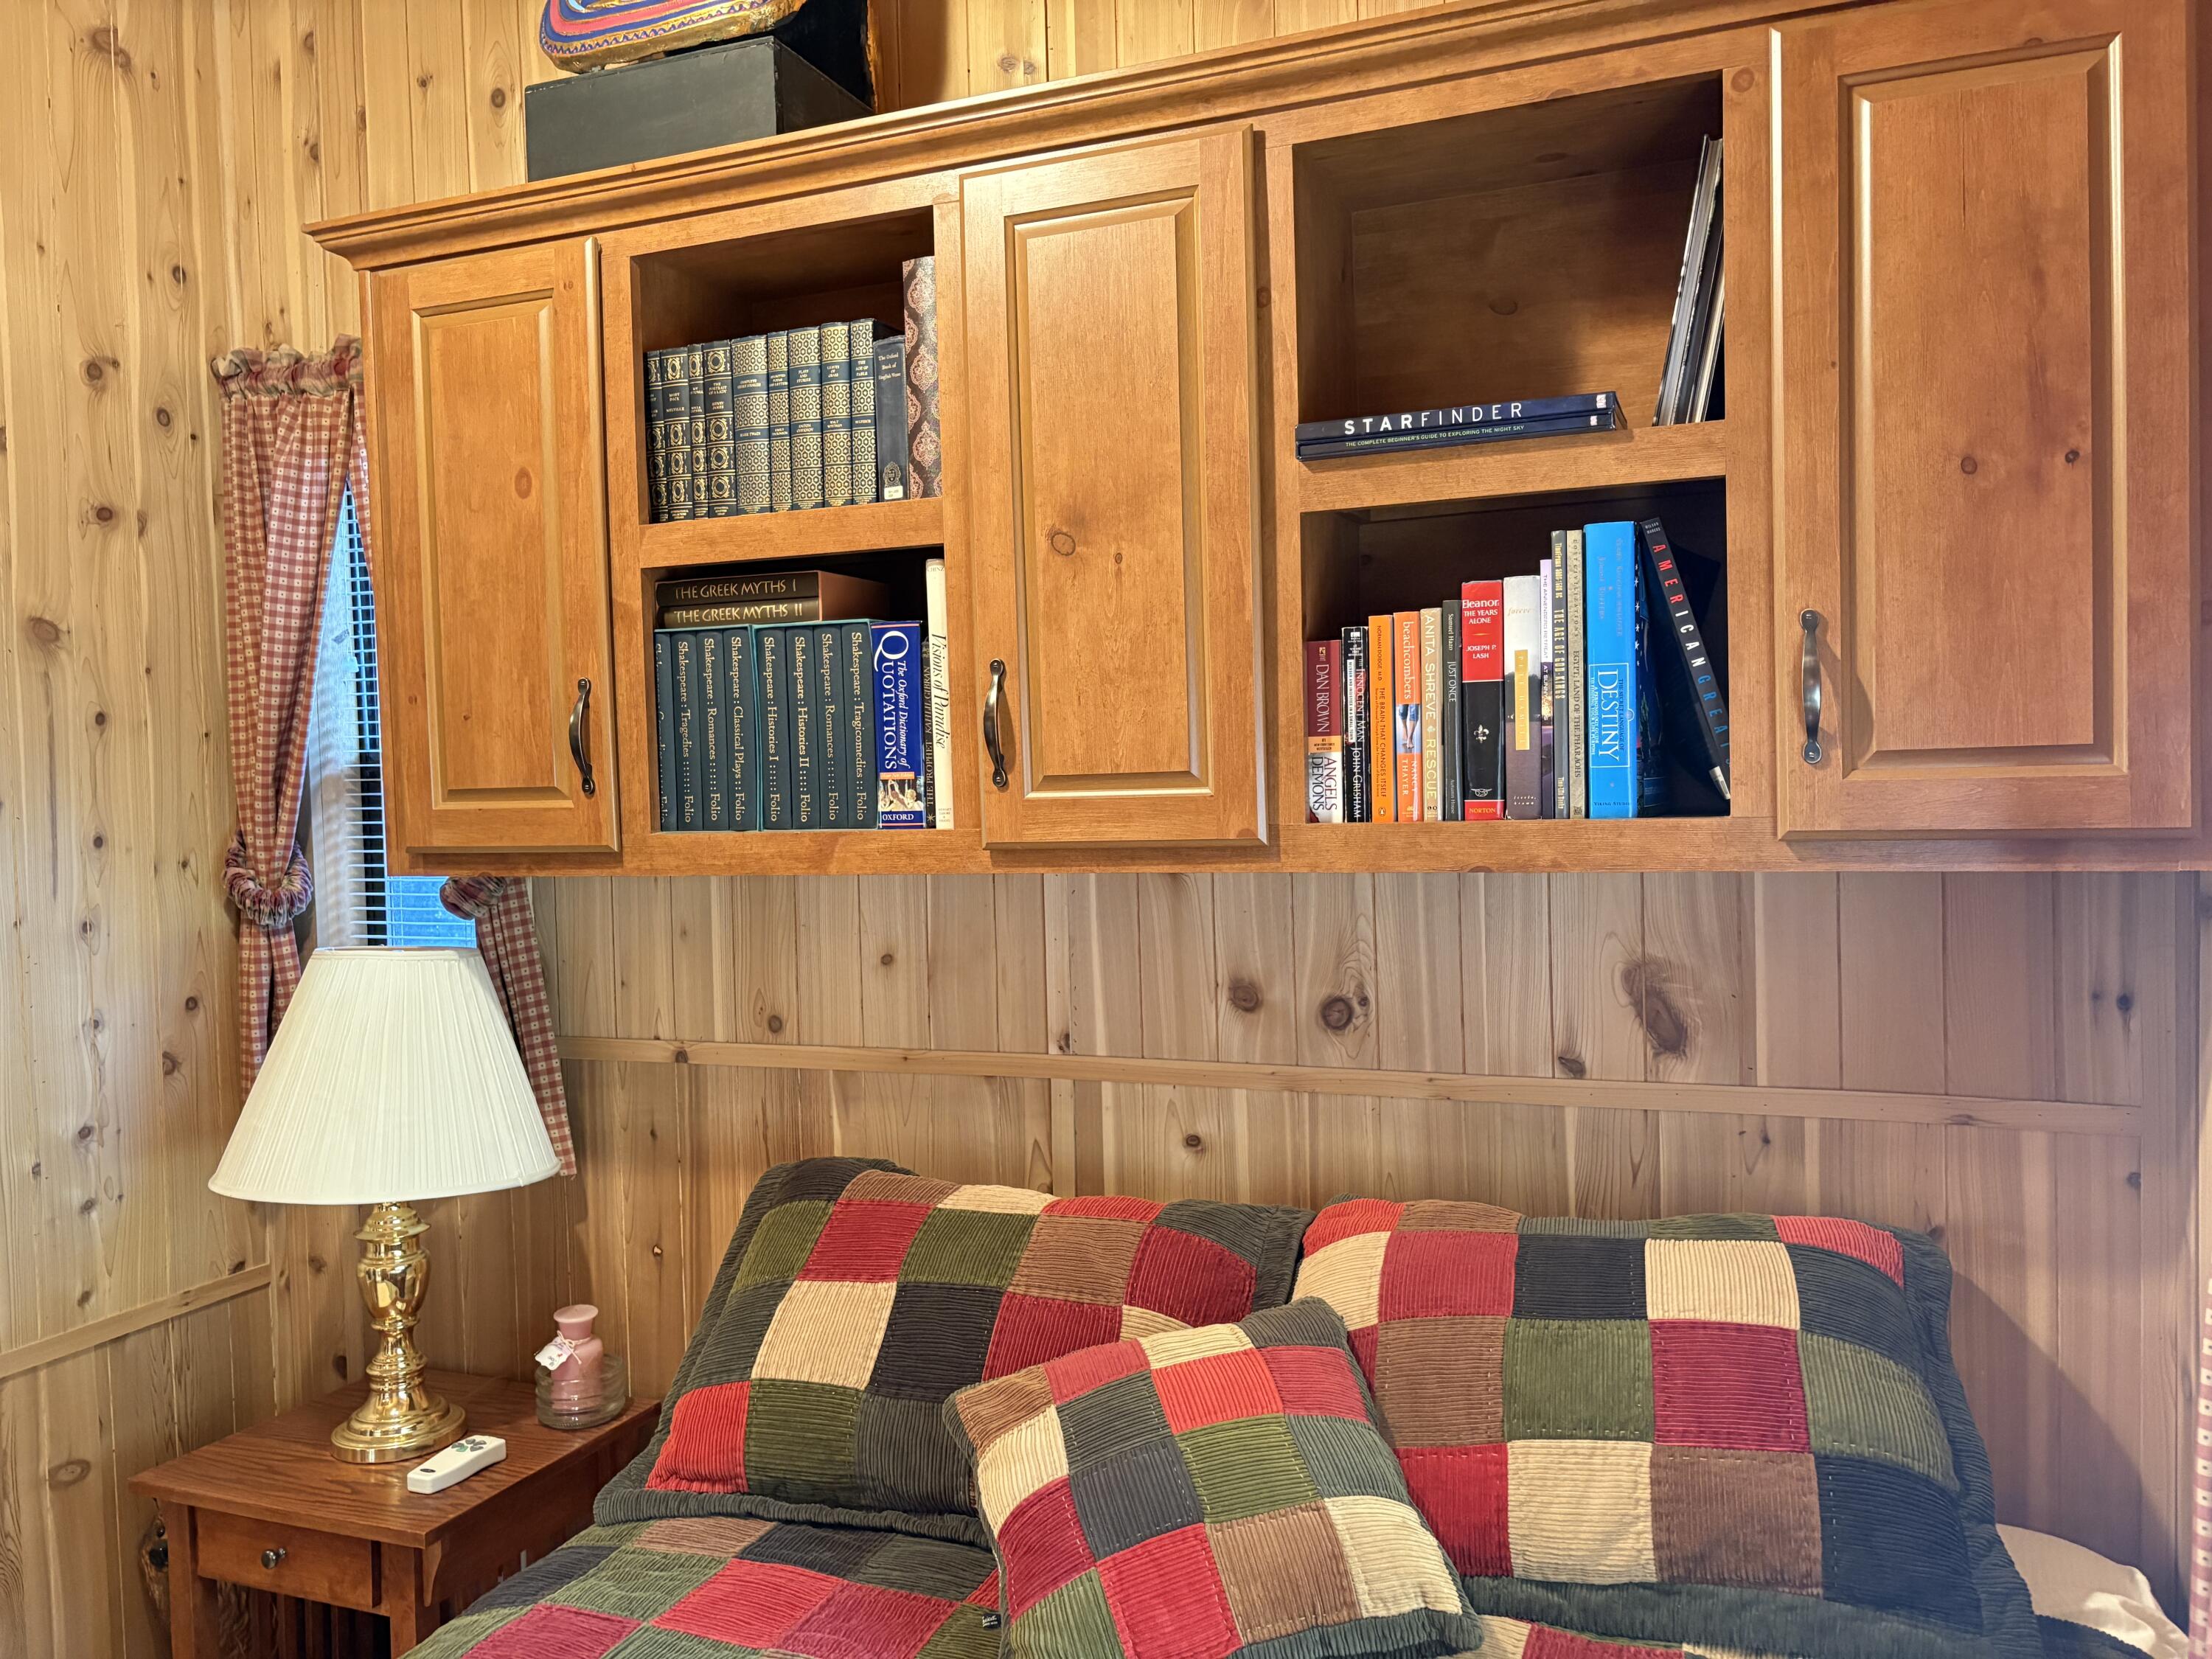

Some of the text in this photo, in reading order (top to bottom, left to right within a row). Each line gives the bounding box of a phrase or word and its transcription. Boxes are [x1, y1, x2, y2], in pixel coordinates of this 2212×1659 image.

[1344, 403, 1521, 435] STARFINDER
[1357, 438, 1386, 446] COMPLETE
[1388, 435, 1419, 443] BEGINNER'S
[1448, 429, 1480, 437] EXPLORING
[675, 579, 796, 599] THE GREEK MYTHS I
[1652, 544, 1706, 667] AMERICAN
[674, 603, 802, 624] THE GREEK MYTHS II
[1468, 616, 1491, 625] ALONE
[931, 634, 947, 678] Visions
[1425, 618, 1435, 656] ANITA
[1554, 609, 1565, 699] THE AGE OF GOD-KINGS
[1316, 664, 1329, 689] DAN
[1403, 622, 1415, 700] beachcombers
[1447, 661, 1457, 703] JUST ONCE
[874, 630, 909, 769] QUOTATIONS
[932, 680, 949, 695] of
[1356, 669, 1366, 716] INNOCENT
[1425, 663, 1436, 720] SHREVE
[1573, 703, 1580, 713] OF
[734, 706, 745, 749] Classical
[768, 706, 778, 754] Histories
[798, 707, 809, 755] Histories
[825, 705, 835, 758] Romances
[895, 661, 911, 768] The Oxford Dictionary of
[1316, 692, 1330, 732] BROWN
[1357, 720, 1366, 742] MAN
[1597, 668, 1619, 762] DESTINY
[679, 709, 692, 758] Tragedies
[708, 708, 717, 760] Romances
[852, 702, 866, 778] Tragicomedies
[732, 752, 745, 779] Plays
[799, 757, 810, 768] II
[925, 740, 933, 783] PROPHET
[1351, 747, 1363, 818] JOHN GRISHAM
[1426, 739, 1437, 799] RESCUE
[925, 786, 933, 807] THE
[1312, 757, 1324, 810] DEMONS
[1324, 757, 1337, 810] ANGELS
[684, 796, 695, 823] Folio
[710, 793, 721, 821] Folio
[735, 793, 745, 821] Folio
[770, 793, 781, 821] Folio
[801, 794, 811, 822] Folio
[829, 792, 839, 820] Folio
[857, 792, 867, 820] Folio
